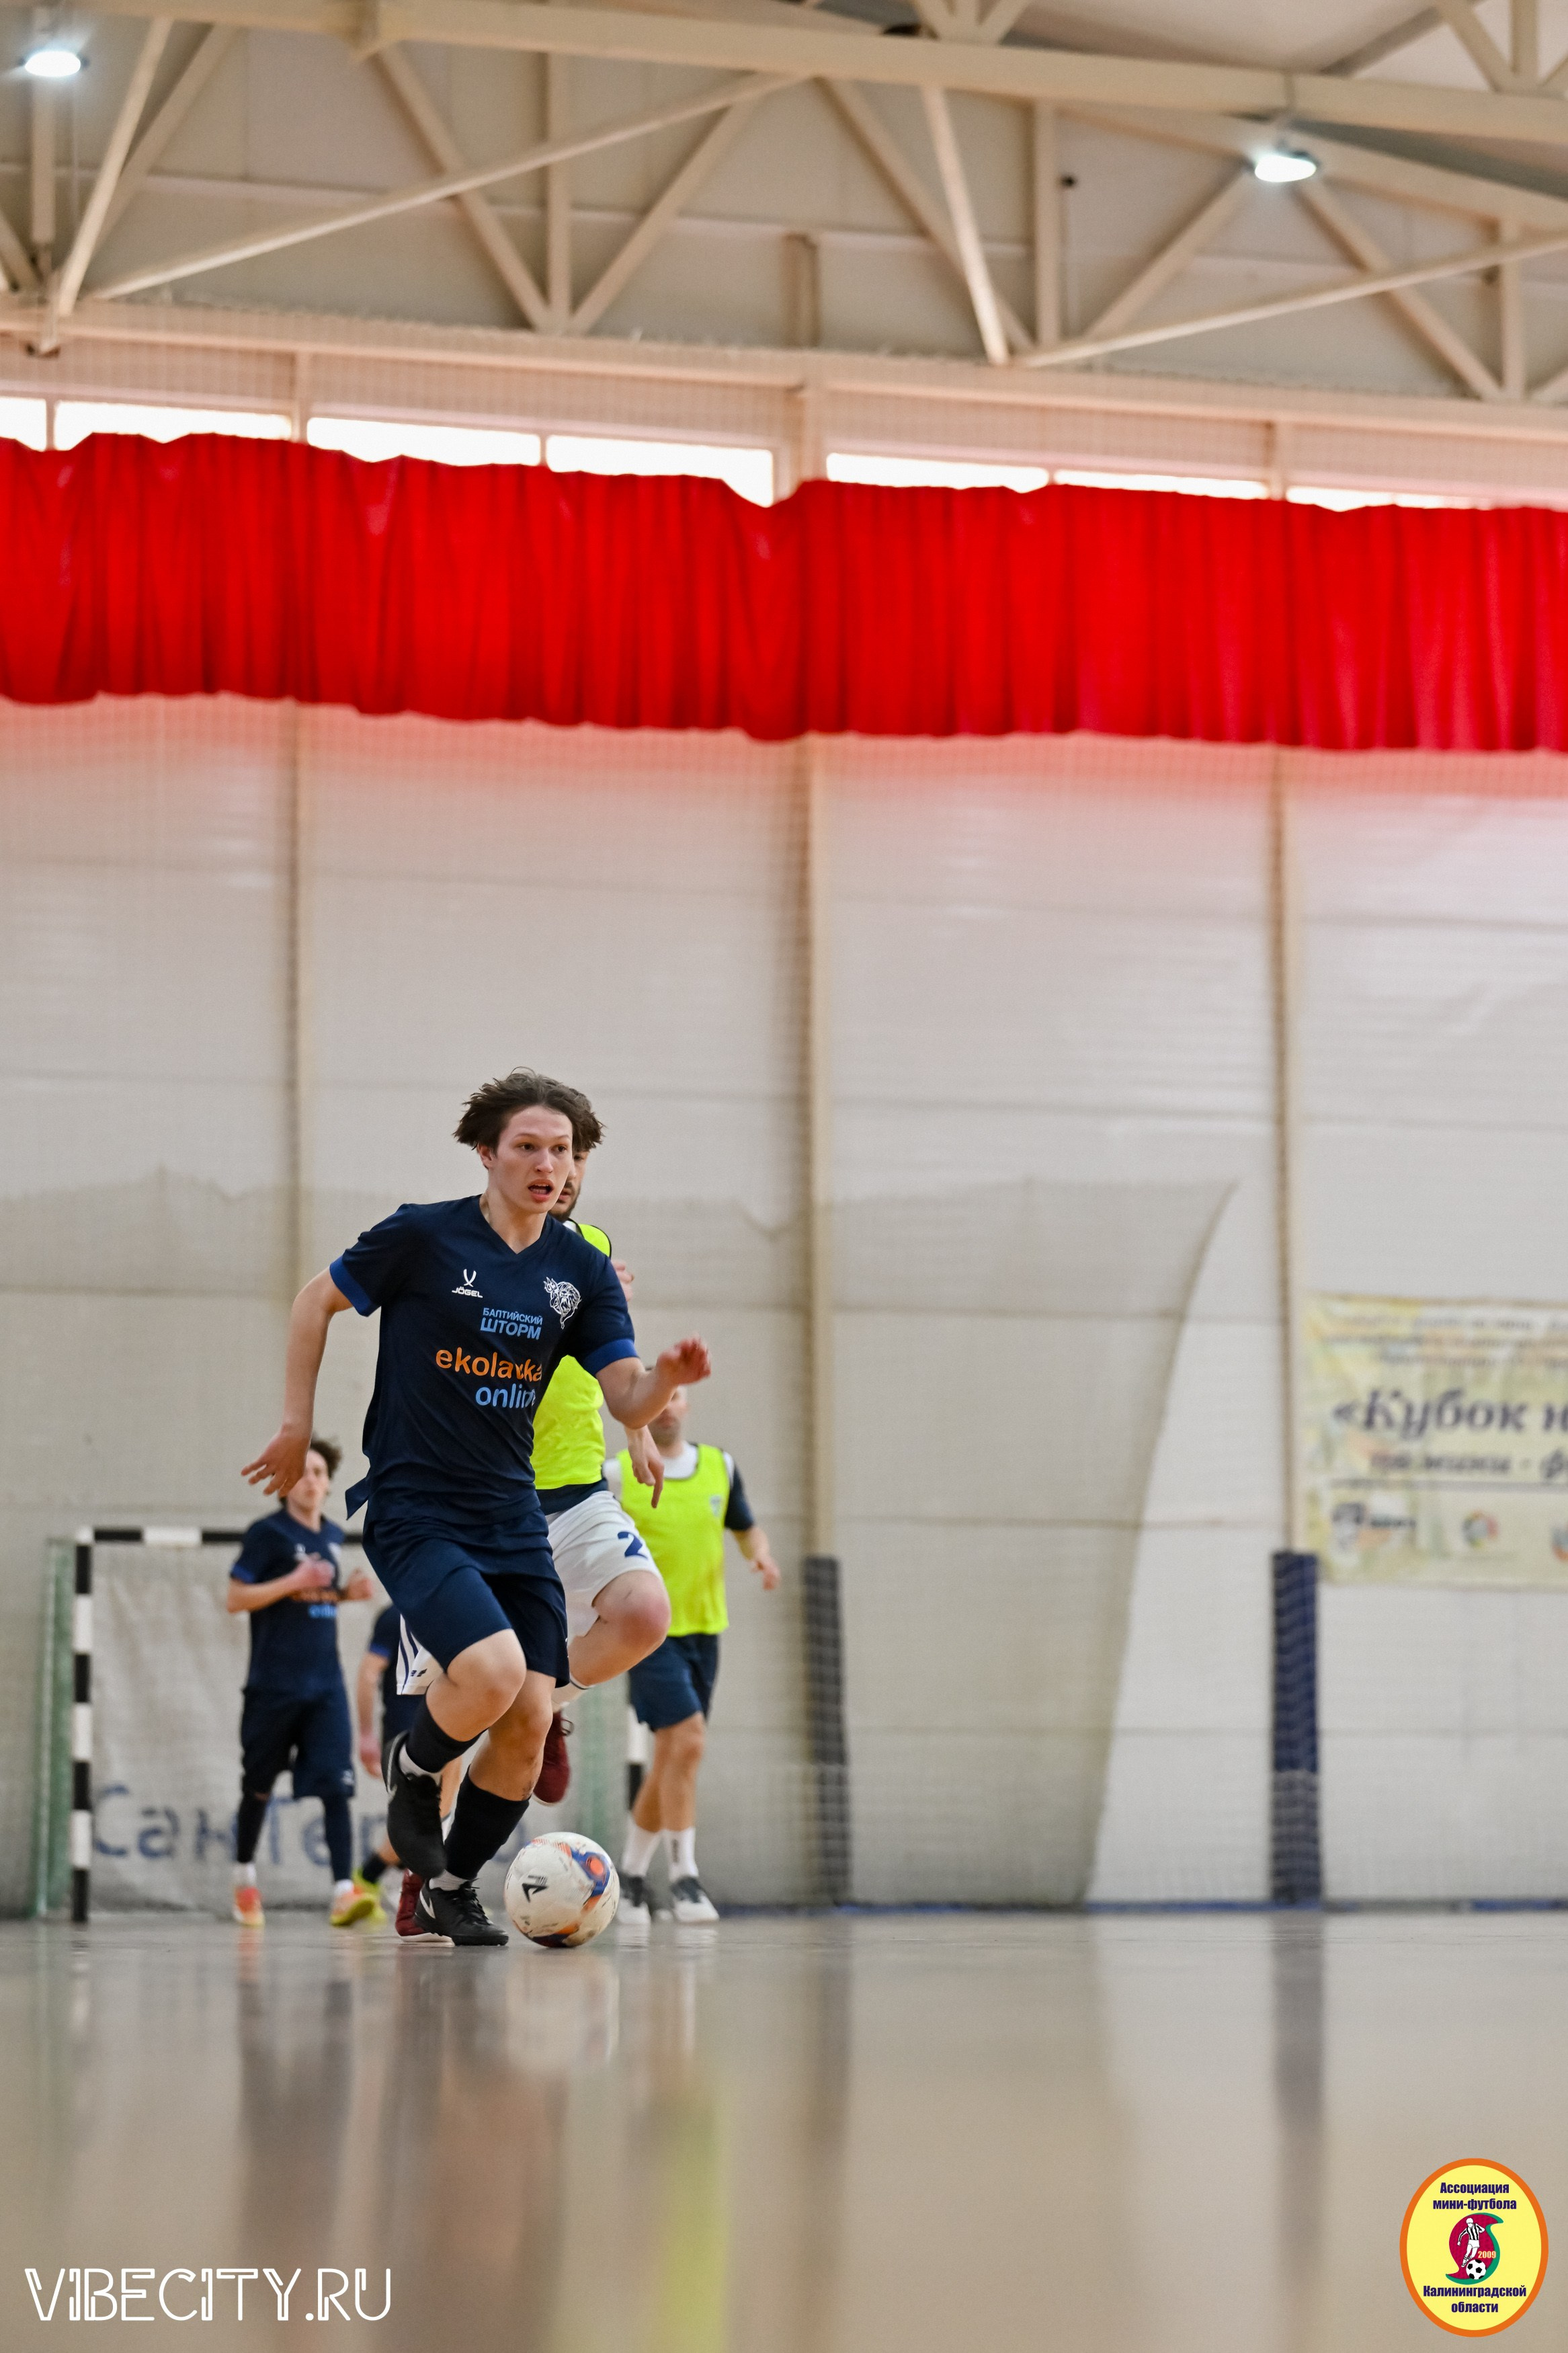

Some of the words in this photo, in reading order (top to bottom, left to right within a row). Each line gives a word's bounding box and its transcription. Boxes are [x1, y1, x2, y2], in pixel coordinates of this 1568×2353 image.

[452, 1286, 483, 1298] JÖGEL
[483, 1307, 543, 1325] БАЛТИЙСКИЙ
[480, 1317, 542, 1340] ШТОРМ
[475, 1383, 536, 1408] onlin
[617, 1530, 649, 1560] 2
